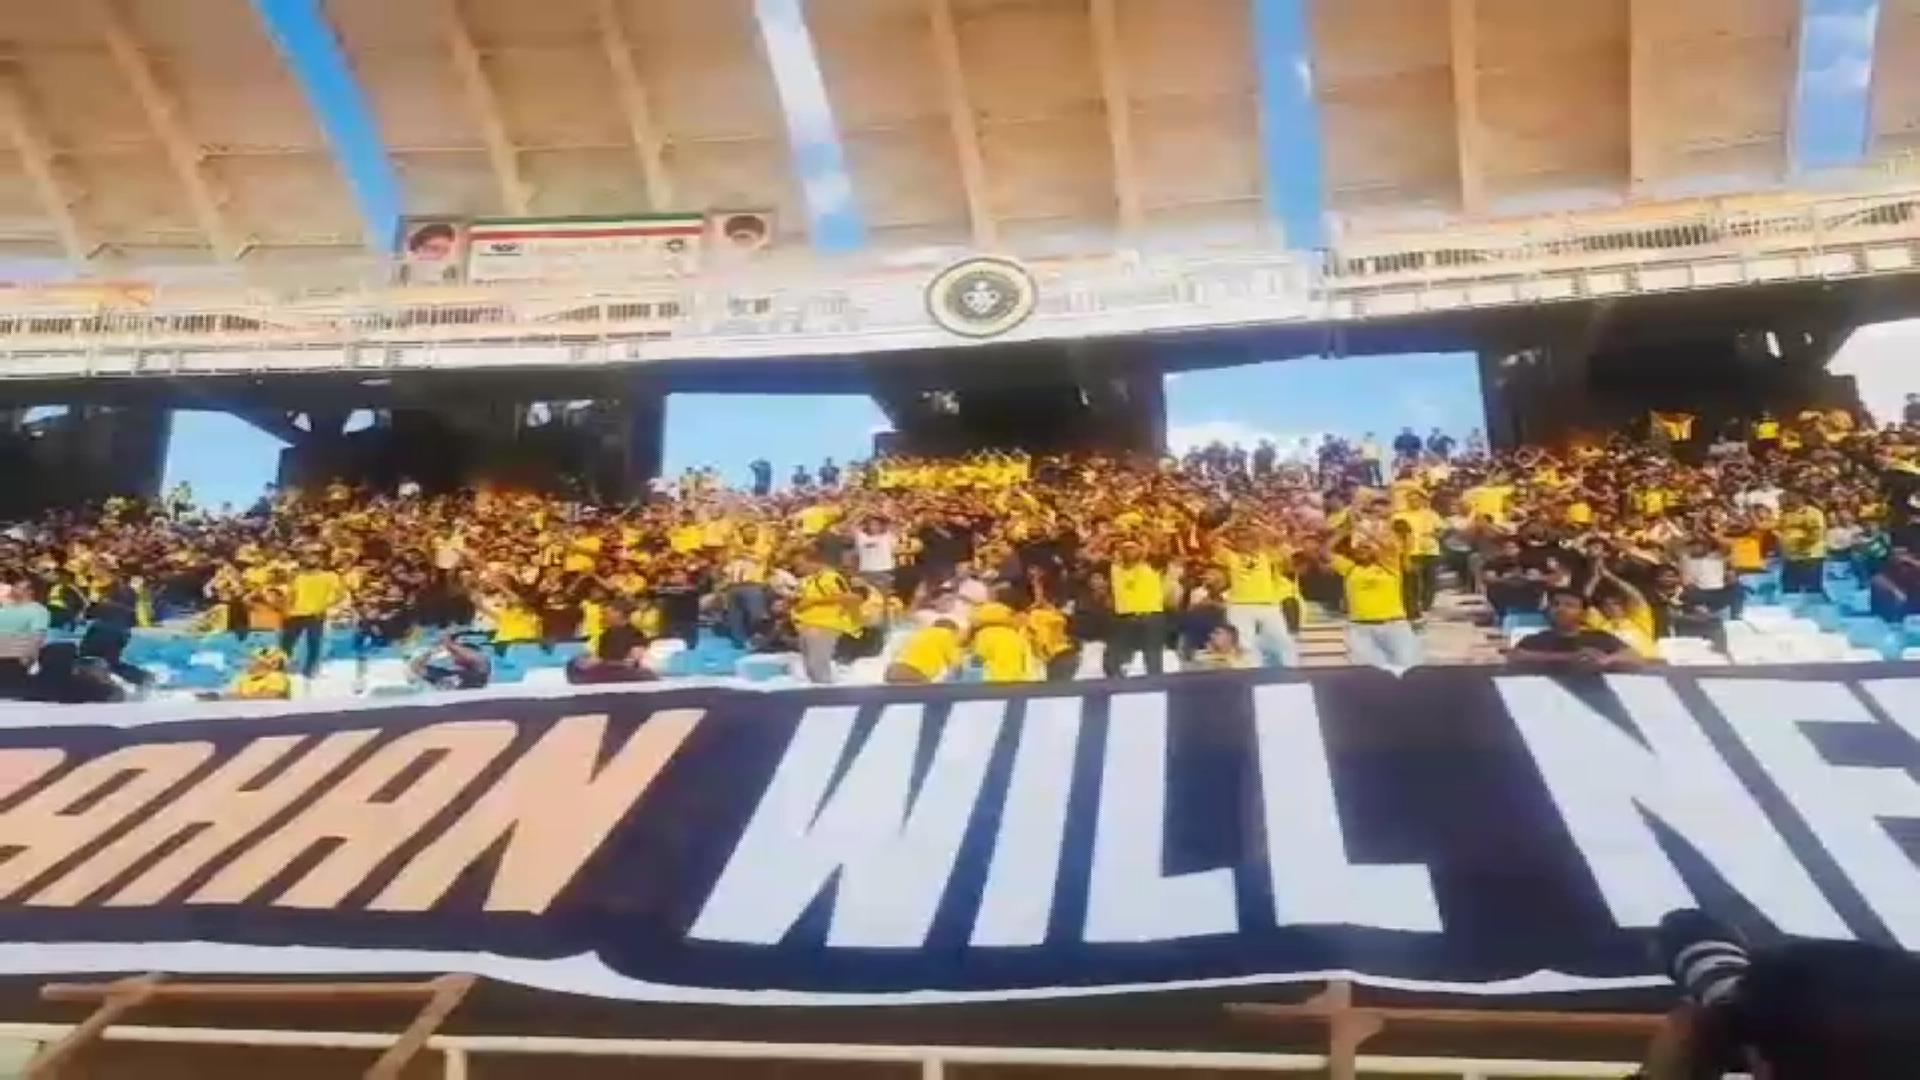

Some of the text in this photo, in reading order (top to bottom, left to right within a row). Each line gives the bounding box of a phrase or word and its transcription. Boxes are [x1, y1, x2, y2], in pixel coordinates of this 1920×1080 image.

[0, 675, 1920, 952] AHAN WILL NE
